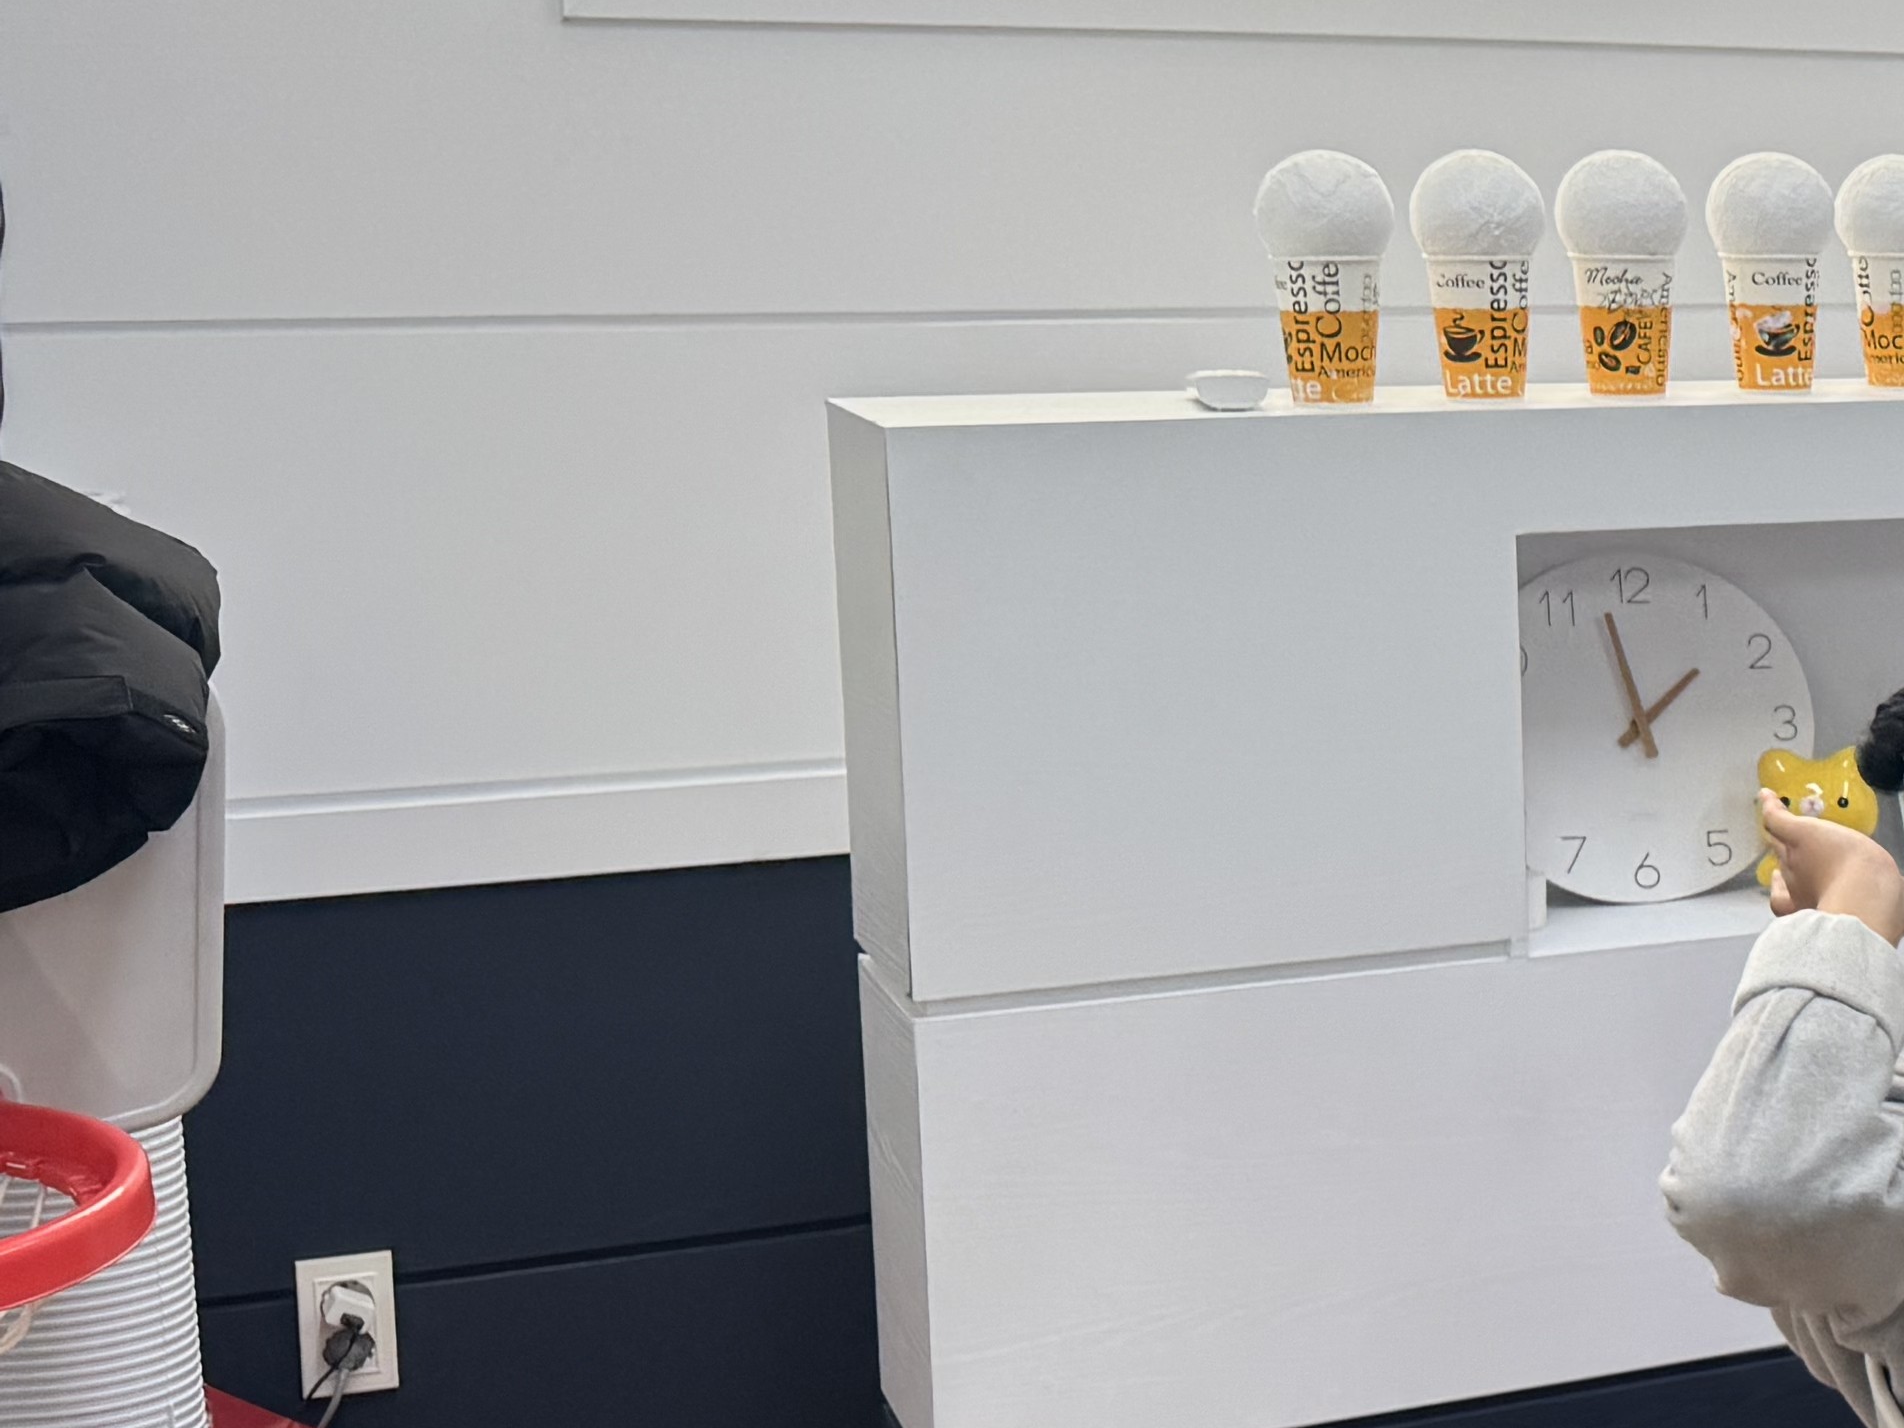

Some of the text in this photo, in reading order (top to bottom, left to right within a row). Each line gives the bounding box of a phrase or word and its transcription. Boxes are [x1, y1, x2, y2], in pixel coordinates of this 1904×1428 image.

[1436, 273, 1486, 289] Coffee
[1751, 271, 1803, 286] Coffee
[1445, 370, 1513, 396] Latte
[1609, 566, 1651, 604] 12
[1696, 584, 1708, 620] 1
[1538, 589, 1576, 627] 11
[1747, 633, 1773, 670] 2
[1772, 704, 1798, 741] 3
[1559, 835, 1587, 874] 7
[1706, 829, 1732, 867] 5
[1634, 851, 1661, 889] 6
